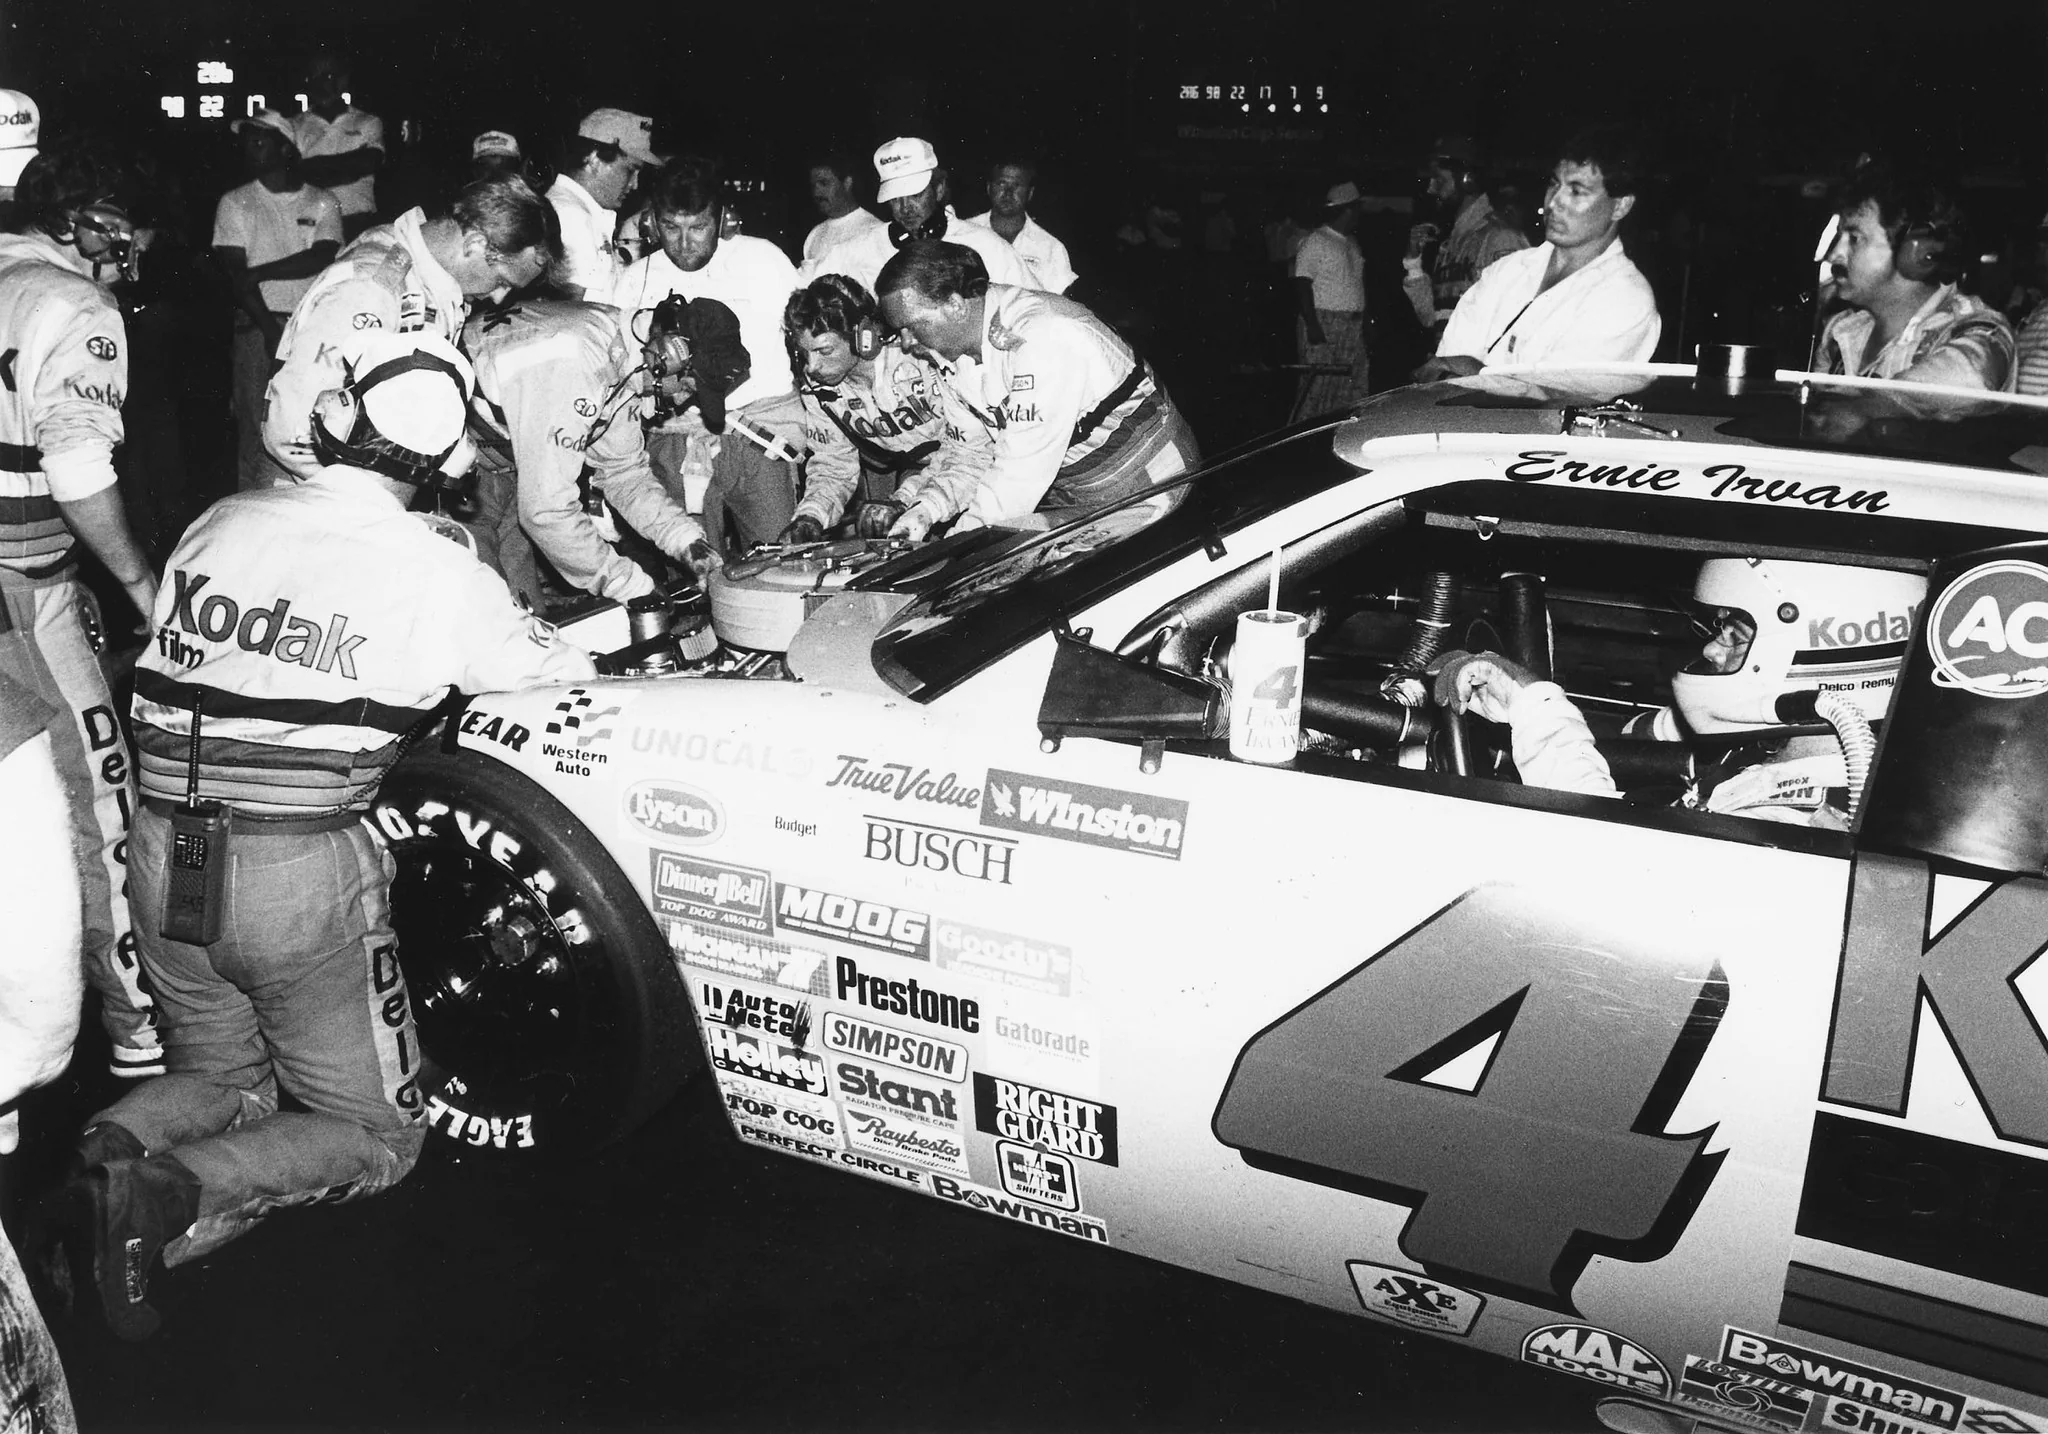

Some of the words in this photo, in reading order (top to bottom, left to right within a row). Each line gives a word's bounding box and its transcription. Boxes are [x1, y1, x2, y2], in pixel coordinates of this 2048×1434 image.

[200, 95, 224, 118] 22
[1230, 86, 1246, 100] 22
[1290, 86, 1297, 100] 7
[0, 109, 33, 126] odak
[1505, 450, 1681, 492] Ernie
[1701, 464, 1890, 514] Irvan
[168, 569, 368, 680] Kodak
[157, 628, 205, 670] film
[1253, 665, 1298, 710] 4
[1818, 682, 1855, 693] Delco
[1861, 677, 1895, 690] Remy
[542, 743, 608, 764] Western
[555, 761, 591, 777] Auto
[629, 724, 779, 775] UNOCAL
[1776, 776, 1810, 789] Kodak
[631, 785, 719, 832] Tyson
[774, 816, 817, 838] Budget
[1018, 786, 1183, 850] Winston
[862, 821, 1014, 886] BUSCH
[660, 900, 686, 912] TOP
[688, 906, 717, 920] DOG
[719, 913, 768, 931] AWARD
[779, 884, 929, 946] MOOG
[728, 988, 796, 1019] Auto
[836, 956, 980, 1034] Prestone
[709, 1027, 825, 1094] Holley
[833, 1018, 956, 1075] SIMPSON
[995, 1015, 1092, 1060] Gatorade
[726, 1093, 778, 1119] TOP
[783, 1109, 835, 1136] COG
[837, 1062, 958, 1121] Stant
[994, 1079, 1103, 1134] RIGHT
[1210, 879, 1732, 1318] 4
[740, 1125, 836, 1159] PERFECT
[840, 1153, 921, 1184] CIRCLE
[846, 1110, 961, 1158] Raybestos
[873, 1137, 894, 1147] Disc
[996, 1109, 1104, 1161] GUARD
[1016, 1183, 1064, 1202] SHIFTERS
[1373, 1276, 1458, 1313] AXE
[1529, 1350, 1663, 1396] TOOLS
[1531, 1329, 1664, 1384] MAC
